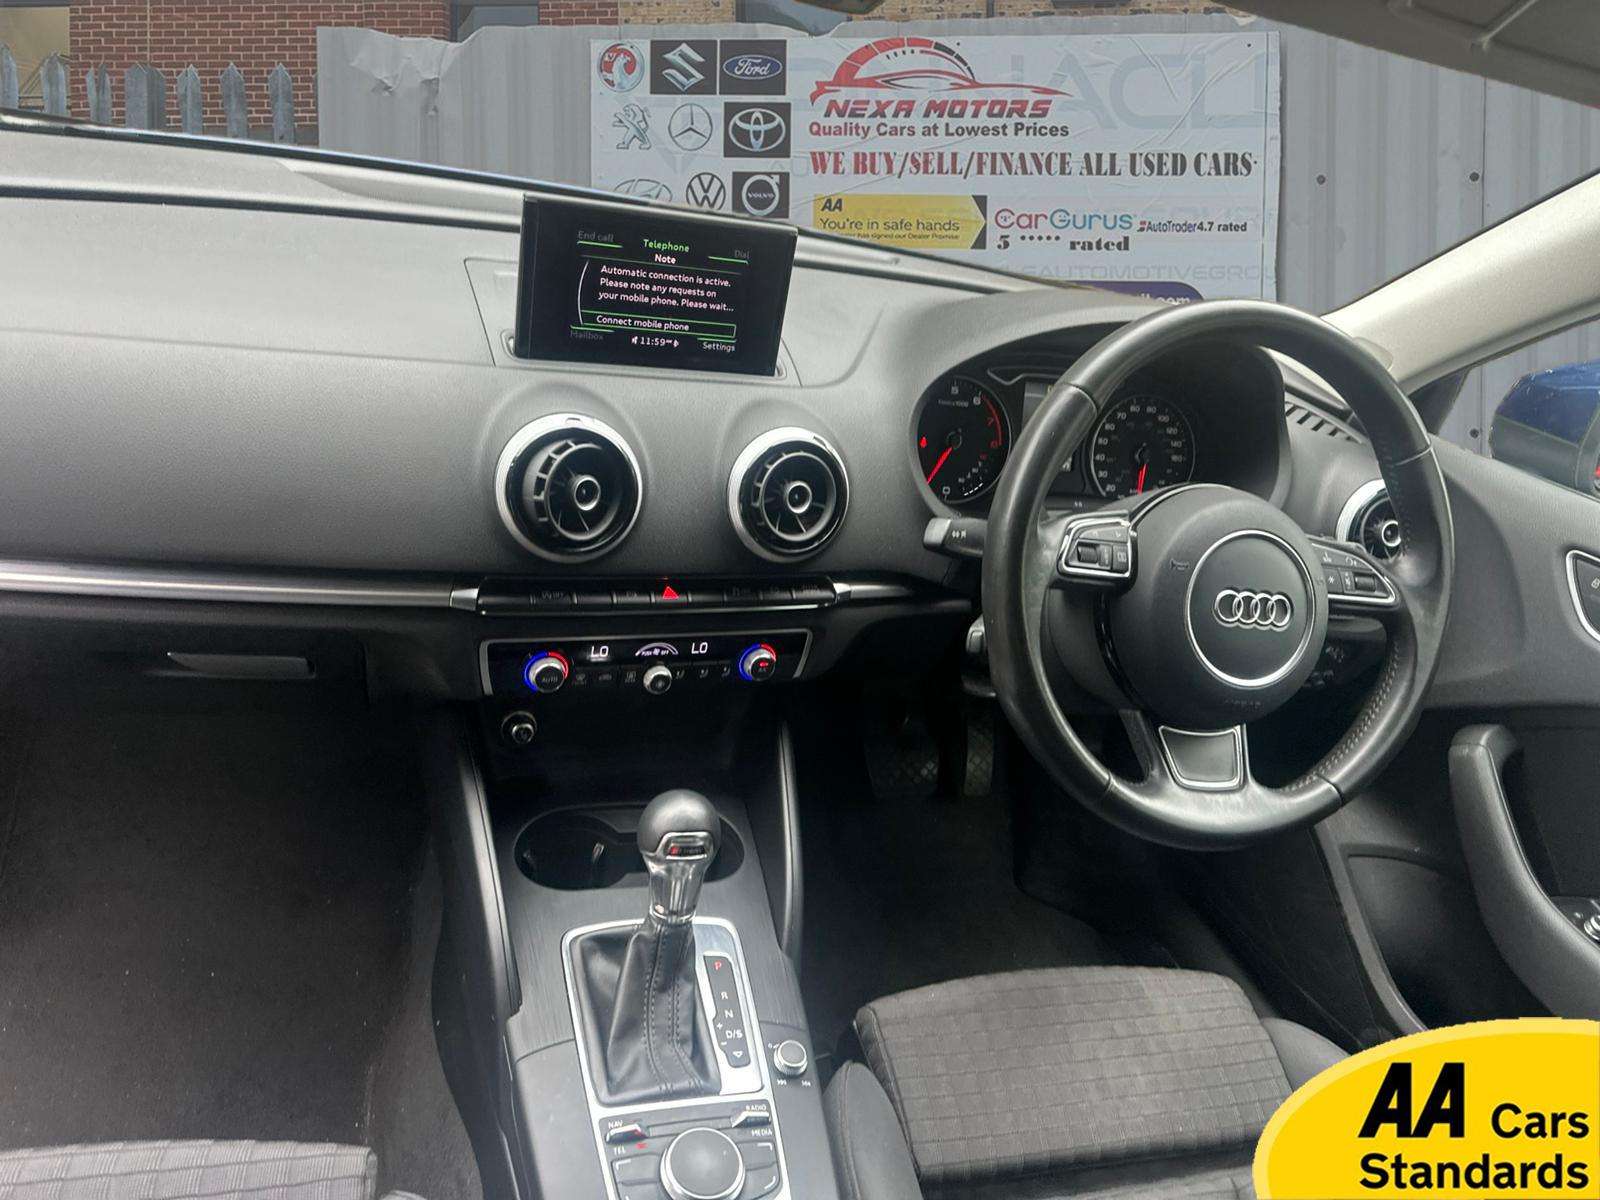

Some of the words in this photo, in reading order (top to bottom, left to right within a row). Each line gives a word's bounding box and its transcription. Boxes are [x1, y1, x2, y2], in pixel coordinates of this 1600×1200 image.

[733, 58, 770, 76] Ford
[823, 99, 916, 119] NEXA
[922, 99, 1053, 119] MOTORS
[809, 121, 871, 140] Quality
[876, 122, 916, 137] Cars
[921, 122, 940, 137] at
[944, 122, 1008, 137] Lowest
[1013, 122, 1070, 137] Prices
[810, 151, 846, 175] WE
[1079, 152, 1122, 176] ALL
[1129, 152, 1188, 177] USED
[1193, 152, 1253, 177] CARS
[747, 191, 775, 199] VOLVO
[820, 198, 843, 212] AA
[819, 217, 864, 231] You're
[866, 218, 880, 231] in
[883, 217, 913, 231] safe
[916, 218, 961, 232] hands
[994, 208, 1134, 230] CarGurus
[1216, 221, 1248, 233] rated
[577, 230, 596, 240] End
[597, 232, 614, 242] call
[643, 238, 690, 253] Telephone
[996, 234, 1011, 250] 5
[1069, 235, 1130, 251] rated
[654, 253, 677, 265] Note
[734, 249, 750, 260] Dial
[600, 265, 647, 279] Automatic
[648, 270, 694, 284] connection
[696, 275, 703, 284] is
[704, 277, 731, 287] active.
[600, 277, 629, 289] Please
[630, 281, 650, 291] note
[651, 284, 668, 295] any
[668, 286, 705, 297] requests
[706, 290, 717, 298] on
[598, 291, 619, 300] your
[620, 292, 649, 303] mobile
[650, 295, 679, 307] phone.
[680, 298, 708, 309] Please
[708, 302, 735, 312] wait...
[596, 315, 632, 326] Connect
[633, 319, 662, 329] mobile
[663, 321, 690, 332] phone
[570, 329, 604, 340] Mailbox
[640, 336, 666, 347] 11:59
[702, 341, 736, 353] Settings
[590, 645, 609, 658] LO
[691, 641, 709, 655] LO
[714, 961, 722, 971] P
[720, 991, 729, 1000] R
[724, 1009, 734, 1019] N
[745, 1103, 767, 1111] RADIO
[608, 1119, 624, 1130] NAV
[751, 1127, 773, 1138] MEDIA
[613, 1144, 626, 1156] TEL
